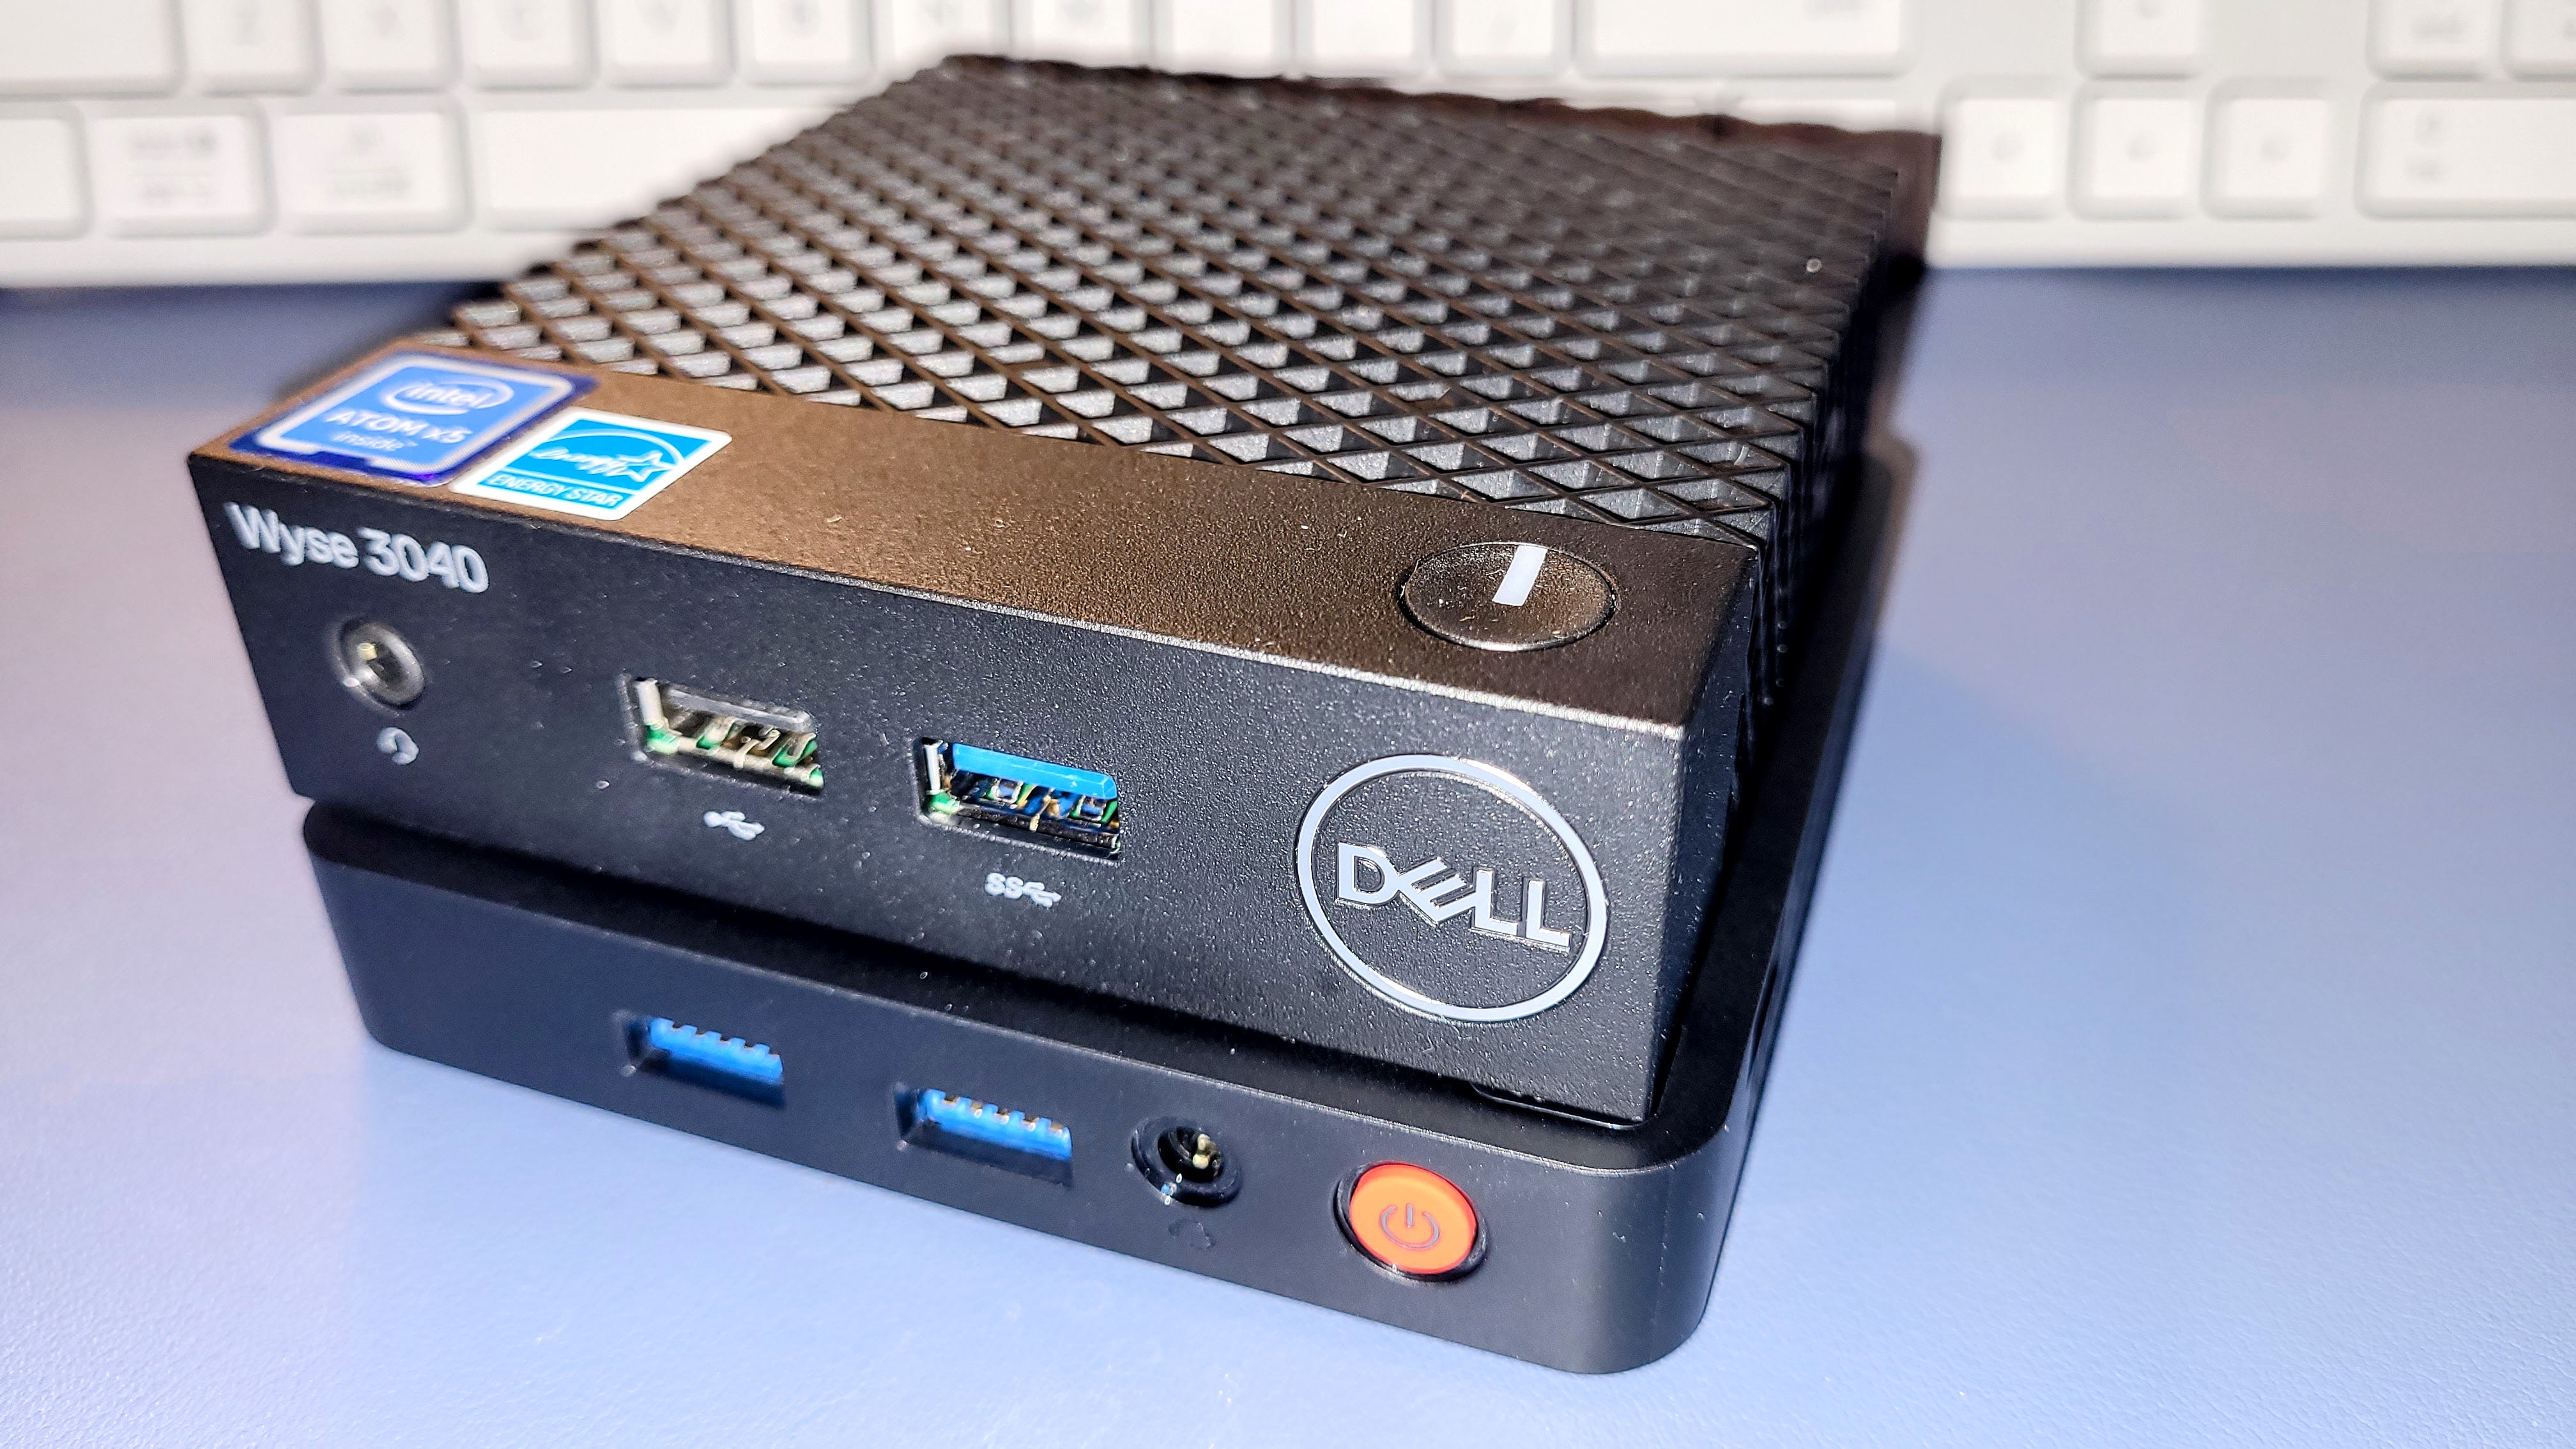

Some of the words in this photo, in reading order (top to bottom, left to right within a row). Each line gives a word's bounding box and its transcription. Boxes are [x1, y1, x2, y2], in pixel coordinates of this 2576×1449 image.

[324, 408, 430, 436] ATOM
[420, 425, 473, 444] x5
[487, 474, 571, 496] ENERGY
[566, 486, 624, 507] STAR
[223, 502, 360, 567] Wyse
[356, 526, 489, 594] 3040
[1338, 841, 1571, 948] DELL
